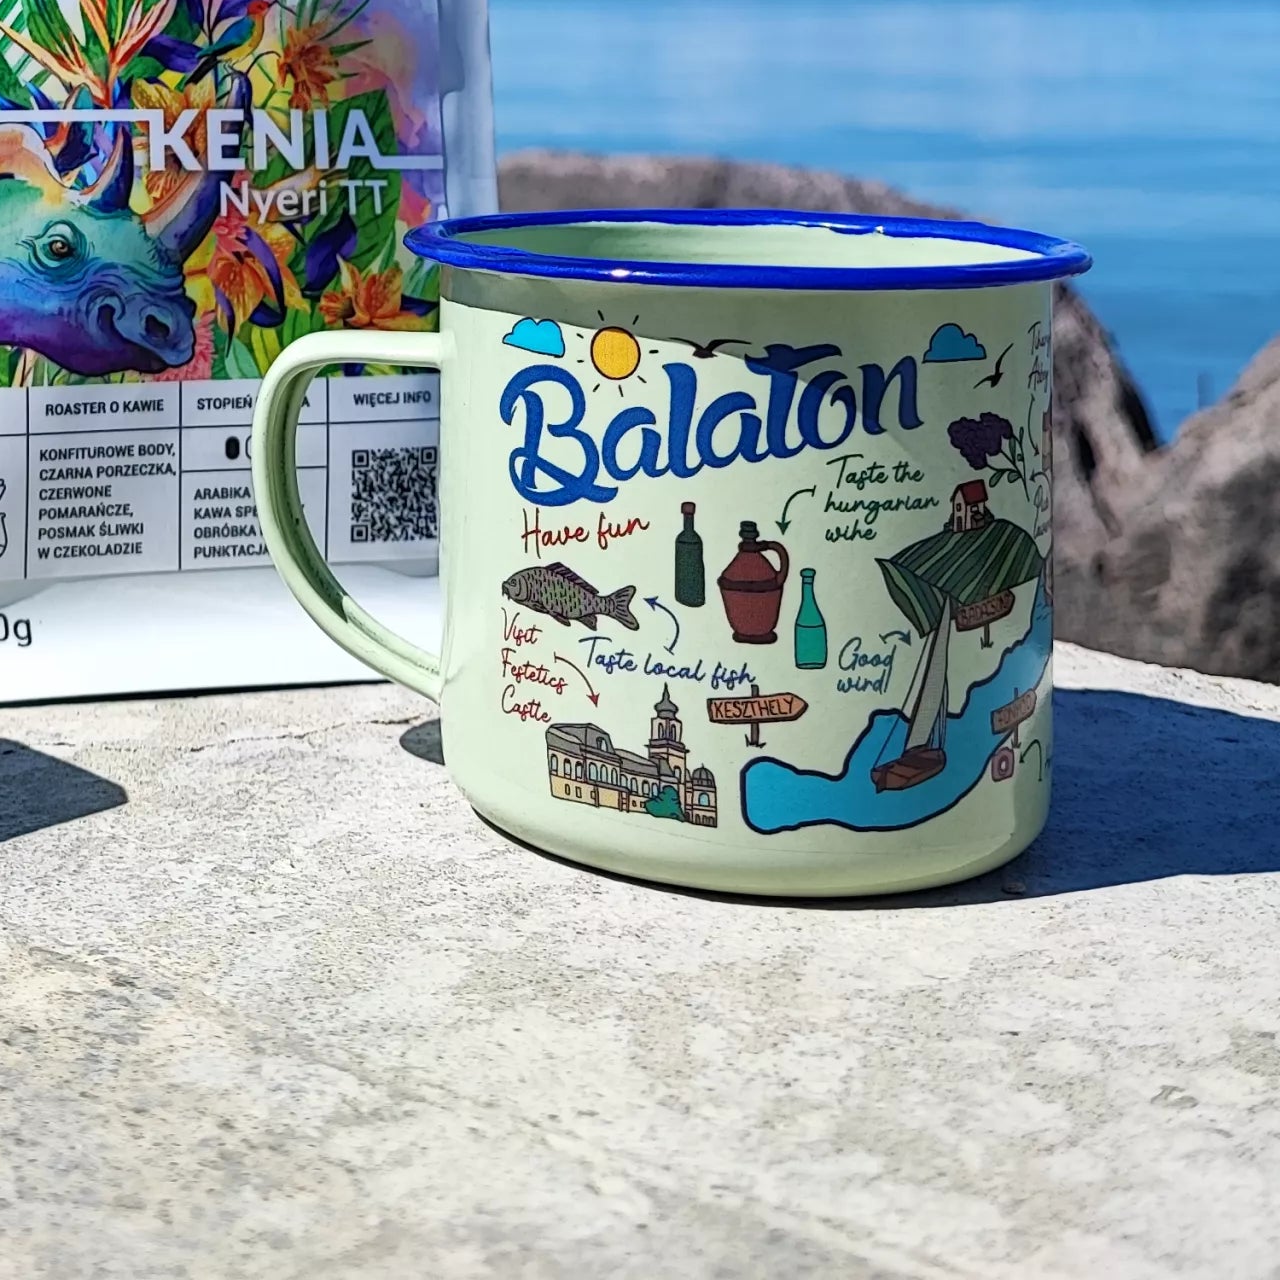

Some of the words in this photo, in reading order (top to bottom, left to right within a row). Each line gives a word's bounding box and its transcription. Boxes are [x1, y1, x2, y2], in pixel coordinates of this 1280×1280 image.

[148, 108, 384, 171] KENIA
[219, 179, 327, 225] Nyeri
[338, 179, 389, 216] TT
[44, 401, 107, 417] ROASTER
[109, 400, 120, 414] O
[122, 398, 165, 414] KAWIE
[196, 393, 253, 411] STOPIEŃ
[352, 391, 401, 408] WIĘCEJ
[402, 389, 433, 405] INFO
[499, 342, 926, 508] Balaton
[39, 445, 135, 462] KONFITUROWE
[137, 443, 177, 459] BODY,
[39, 467, 94, 481] CZARNA
[96, 463, 177, 478] PORZECZKA,
[825, 453, 889, 491] Taste
[891, 460, 926, 484] the
[39, 484, 112, 501] CZERWONE
[193, 486, 252, 501] ARABIKA
[38, 503, 135, 521] POMARAŃCZE,
[193, 506, 232, 521] KAWA
[823, 491, 940, 525] hungarian
[37, 525, 96, 541] POSMAK
[98, 520, 145, 537] ŚLIWKI
[193, 522, 258, 540] OBRÓBKA
[520, 506, 590, 560] Have
[596, 511, 651, 550] fun
[37, 547, 51, 560] W
[52, 542, 143, 560] CZEKOLADZIE
[500, 606, 543, 646] Visit
[577, 635, 639, 675] Taste
[642, 652, 706, 683] local
[710, 662, 757, 691] fish
[837, 636, 897, 675] Good
[500, 647, 569, 696] Festetics
[500, 683, 553, 724] Castle
[711, 695, 795, 720] KESZTHELY
